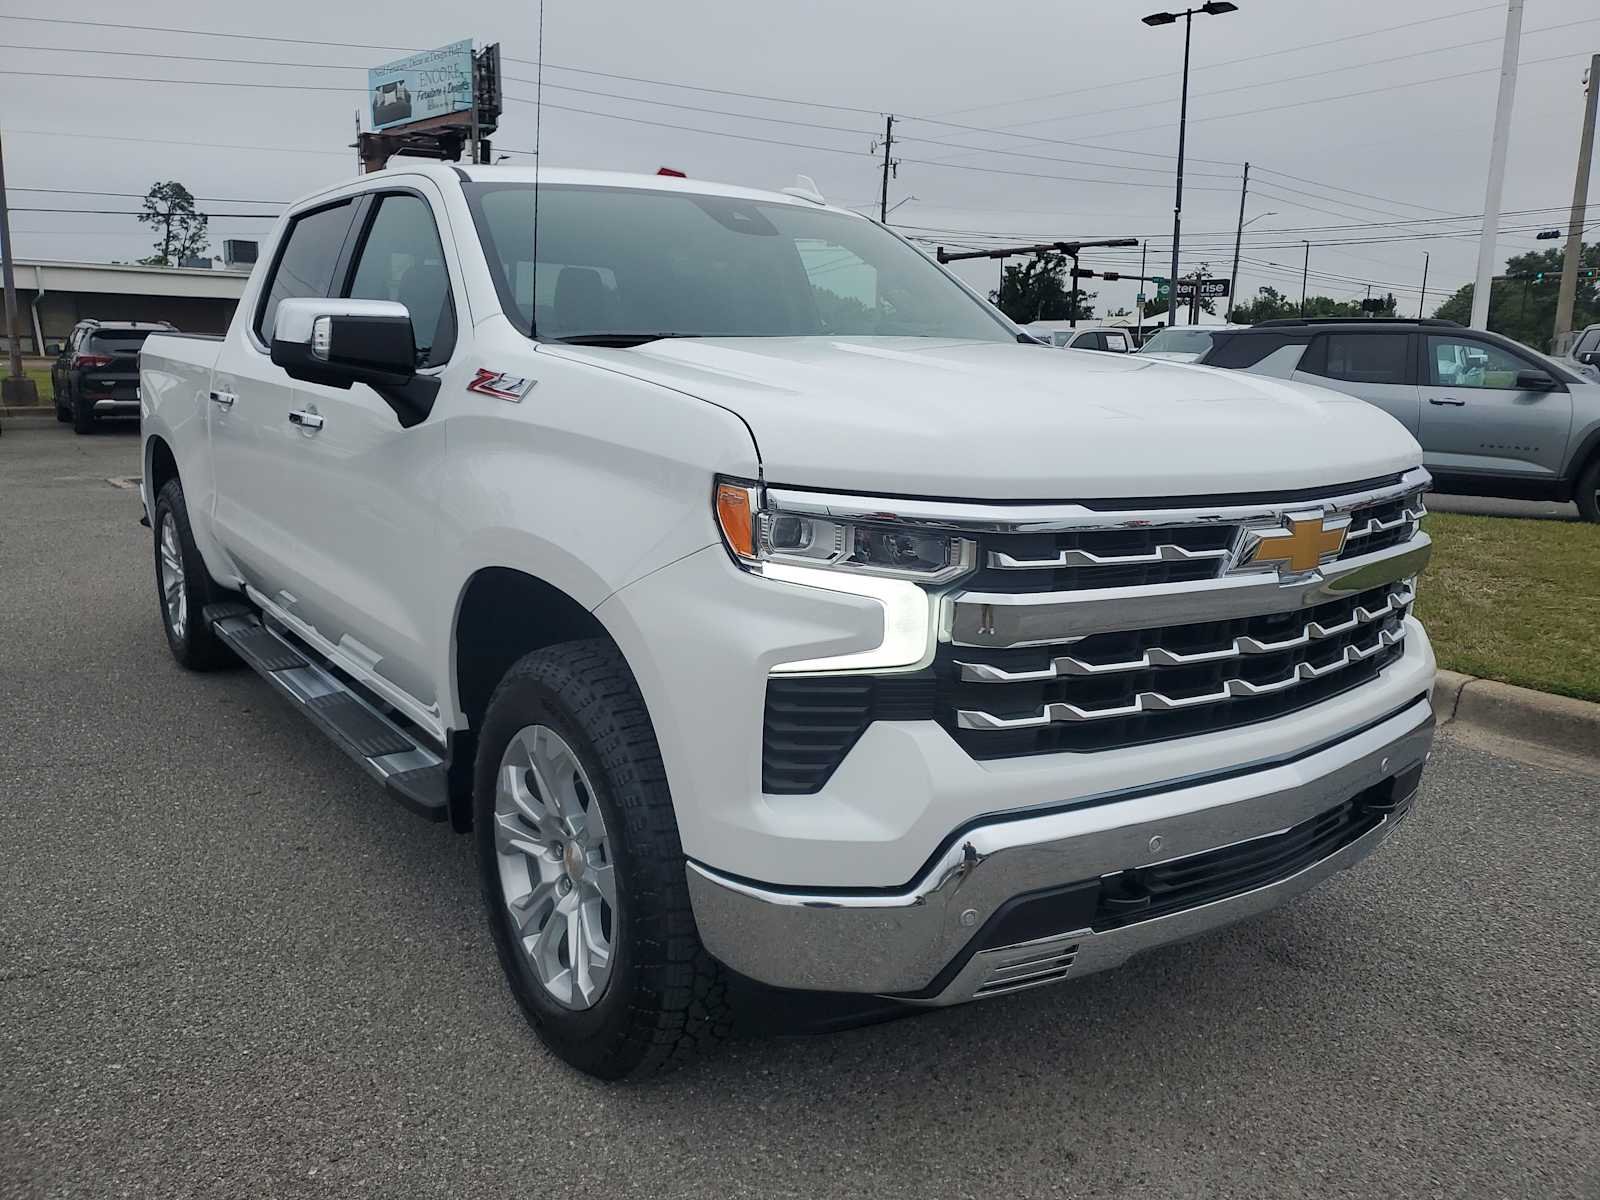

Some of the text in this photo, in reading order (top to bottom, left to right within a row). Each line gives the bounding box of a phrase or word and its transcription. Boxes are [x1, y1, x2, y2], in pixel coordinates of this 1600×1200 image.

[419, 63, 460, 88] ENCORE
[1159, 282, 1224, 296] eterrise
[466, 367, 538, 404] Z71
